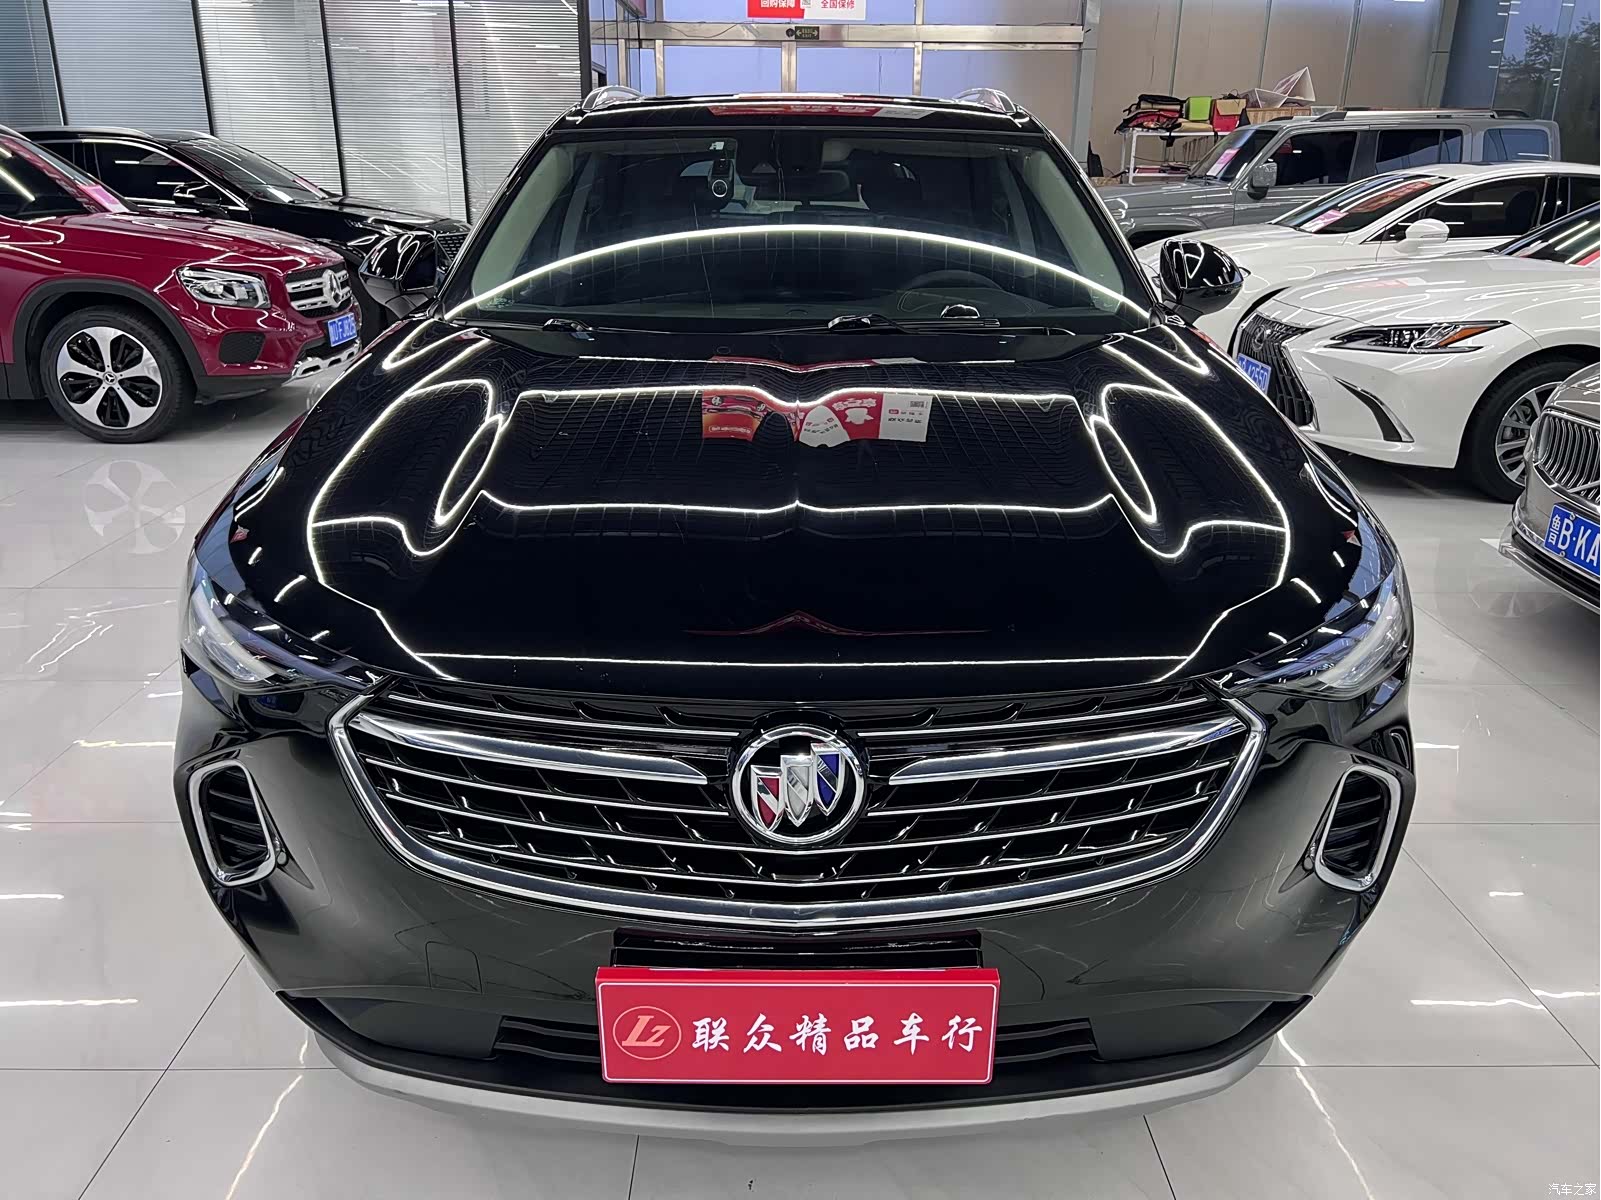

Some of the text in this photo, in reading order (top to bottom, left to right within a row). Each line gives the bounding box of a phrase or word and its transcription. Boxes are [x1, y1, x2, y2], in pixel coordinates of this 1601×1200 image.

[821, 0, 855, 9] 全国保修
[691, 1013, 983, 1056] 联众精品车行
